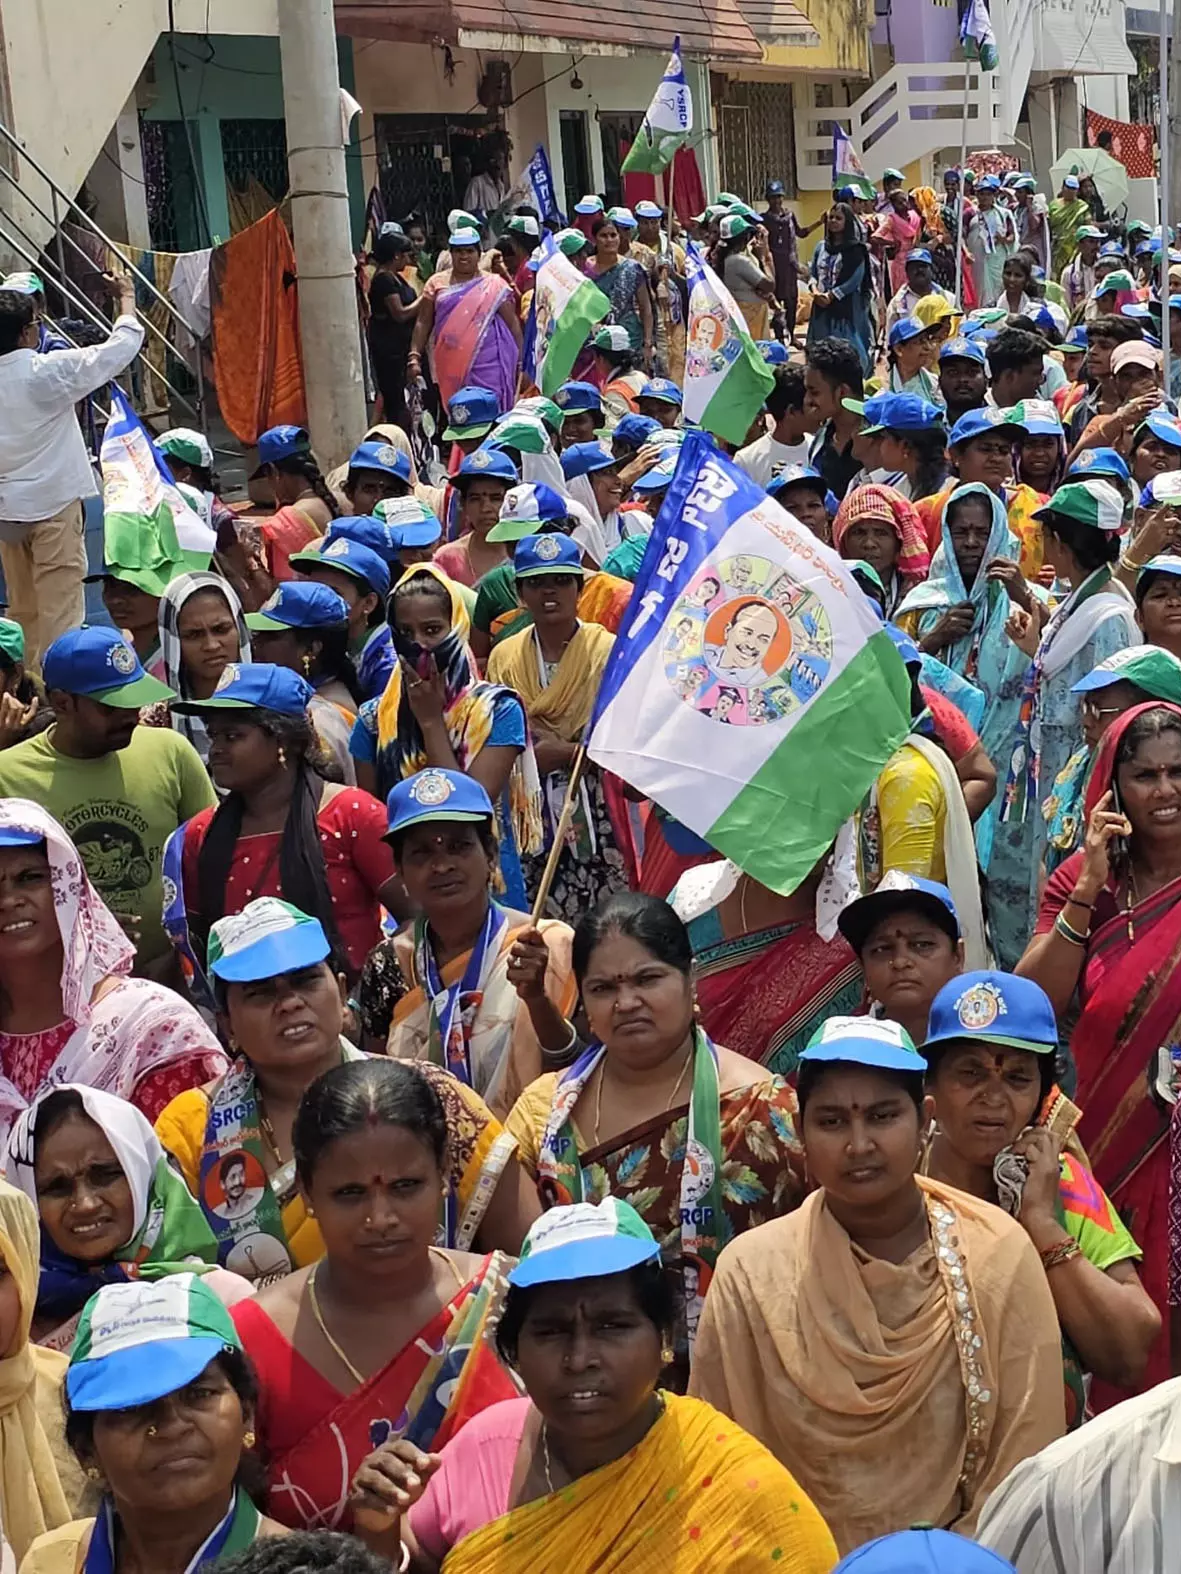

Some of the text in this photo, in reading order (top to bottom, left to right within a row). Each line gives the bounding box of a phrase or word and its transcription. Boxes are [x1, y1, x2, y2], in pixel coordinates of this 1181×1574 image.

[677, 88, 688, 128] YSRCP
[64, 802, 149, 833] OTORCYCLES
[148, 846, 160, 862] 87
[211, 1101, 255, 1129] SRCP
[680, 1207, 714, 1226] RCP
